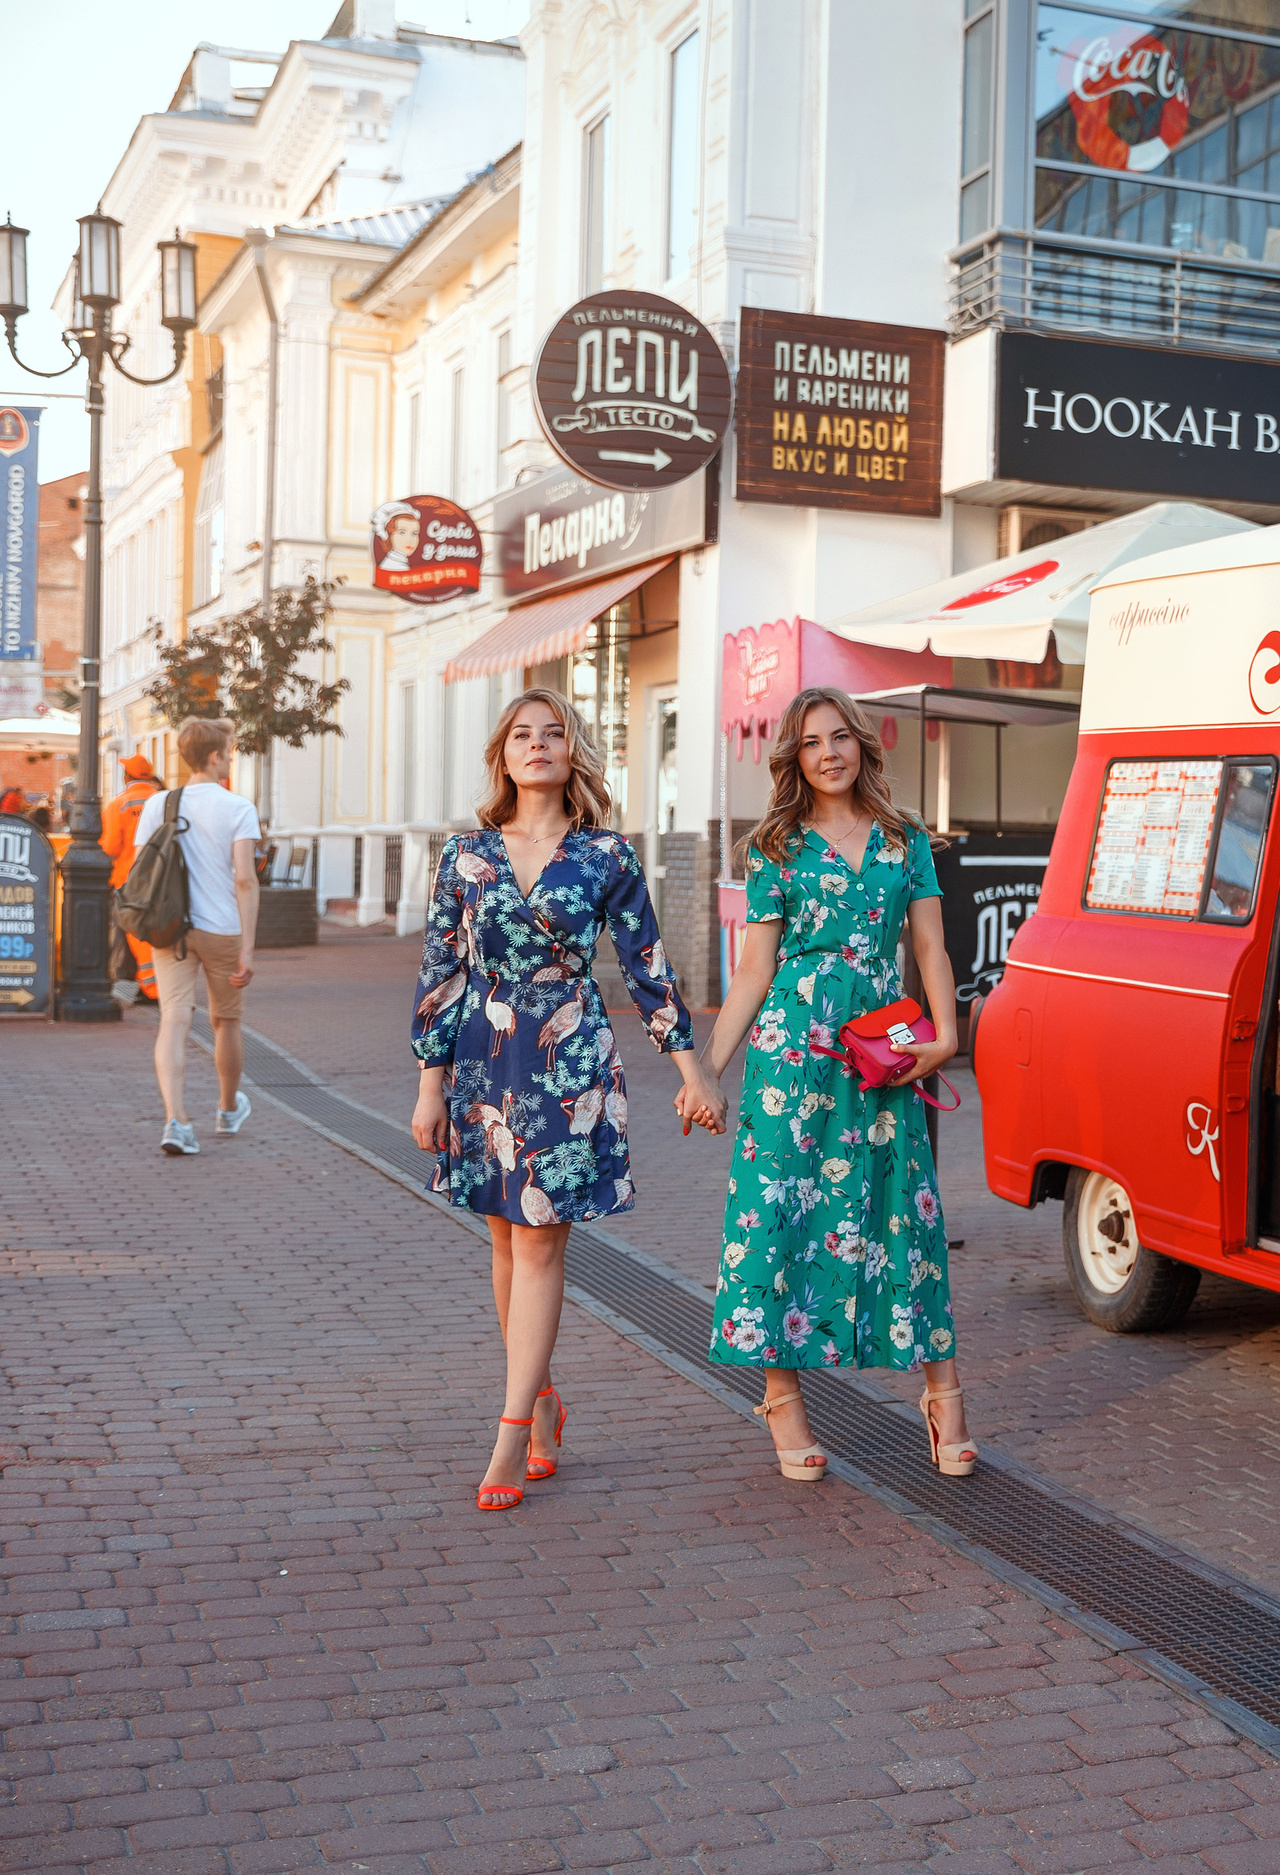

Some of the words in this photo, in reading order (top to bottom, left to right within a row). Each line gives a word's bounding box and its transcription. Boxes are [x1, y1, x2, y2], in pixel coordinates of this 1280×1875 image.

[573, 306, 699, 338] ПЕЛЬМЕННАЯ
[572, 326, 699, 410] ЛЕПИ
[773, 340, 911, 384] ПЕЛЬМЕНИ
[773, 376, 789, 402] И
[797, 379, 910, 415] ВАРЕНИКИ
[604, 407, 675, 431] ТЕСТО
[773, 414, 808, 444] НА
[816, 415, 909, 454] ЛЮБОЙ
[1023, 387, 1241, 451] HOOKAH
[772, 445, 827, 476] ВКУС
[834, 451, 850, 476] И
[856, 454, 906, 482] ЦВЕТ
[7, 463, 26, 562] NOVGOROD
[523, 491, 626, 575] Пекарня
[5, 563, 23, 630] NIZHNY
[389, 567, 468, 586] пекарня
[4, 631, 22, 654] TO
[1109, 598, 1190, 646] cappuccino
[971, 901, 1038, 974] ЛЕ
